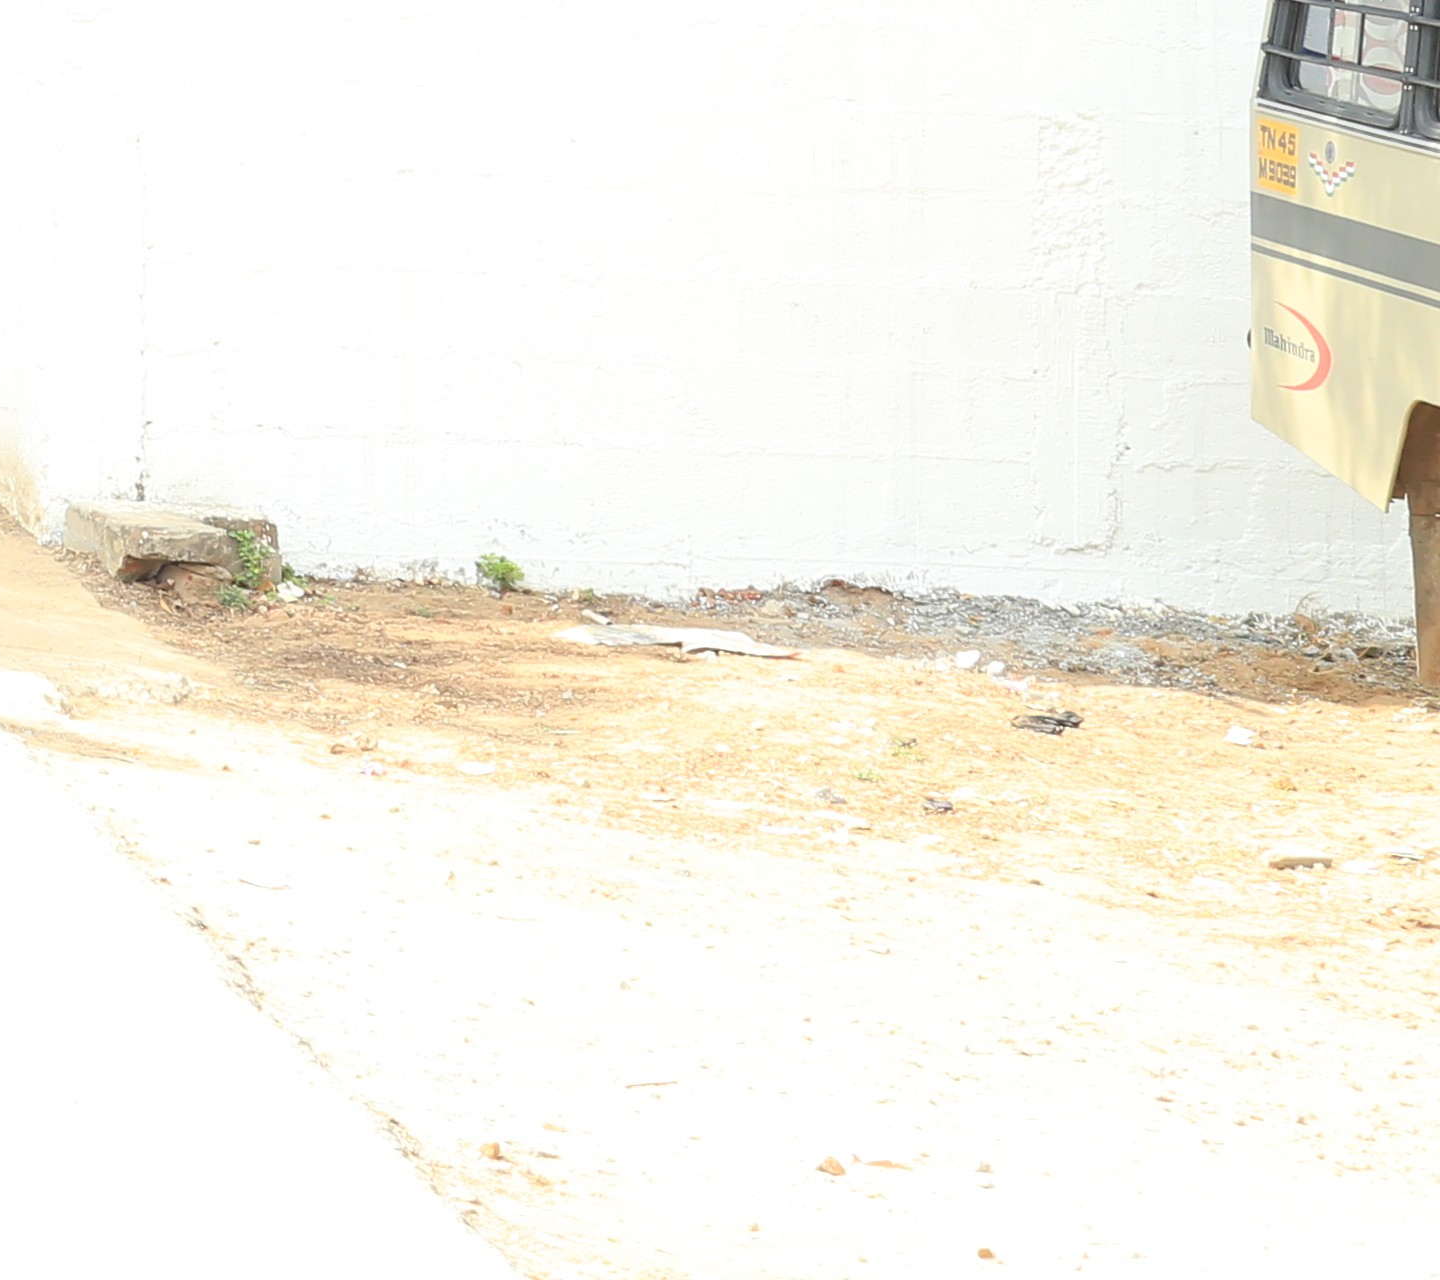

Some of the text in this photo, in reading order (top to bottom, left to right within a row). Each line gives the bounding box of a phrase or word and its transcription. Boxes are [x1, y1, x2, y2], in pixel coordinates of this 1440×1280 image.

[1260, 125, 1297, 155] TN 45
[1264, 326, 1315, 363] Mahindra
